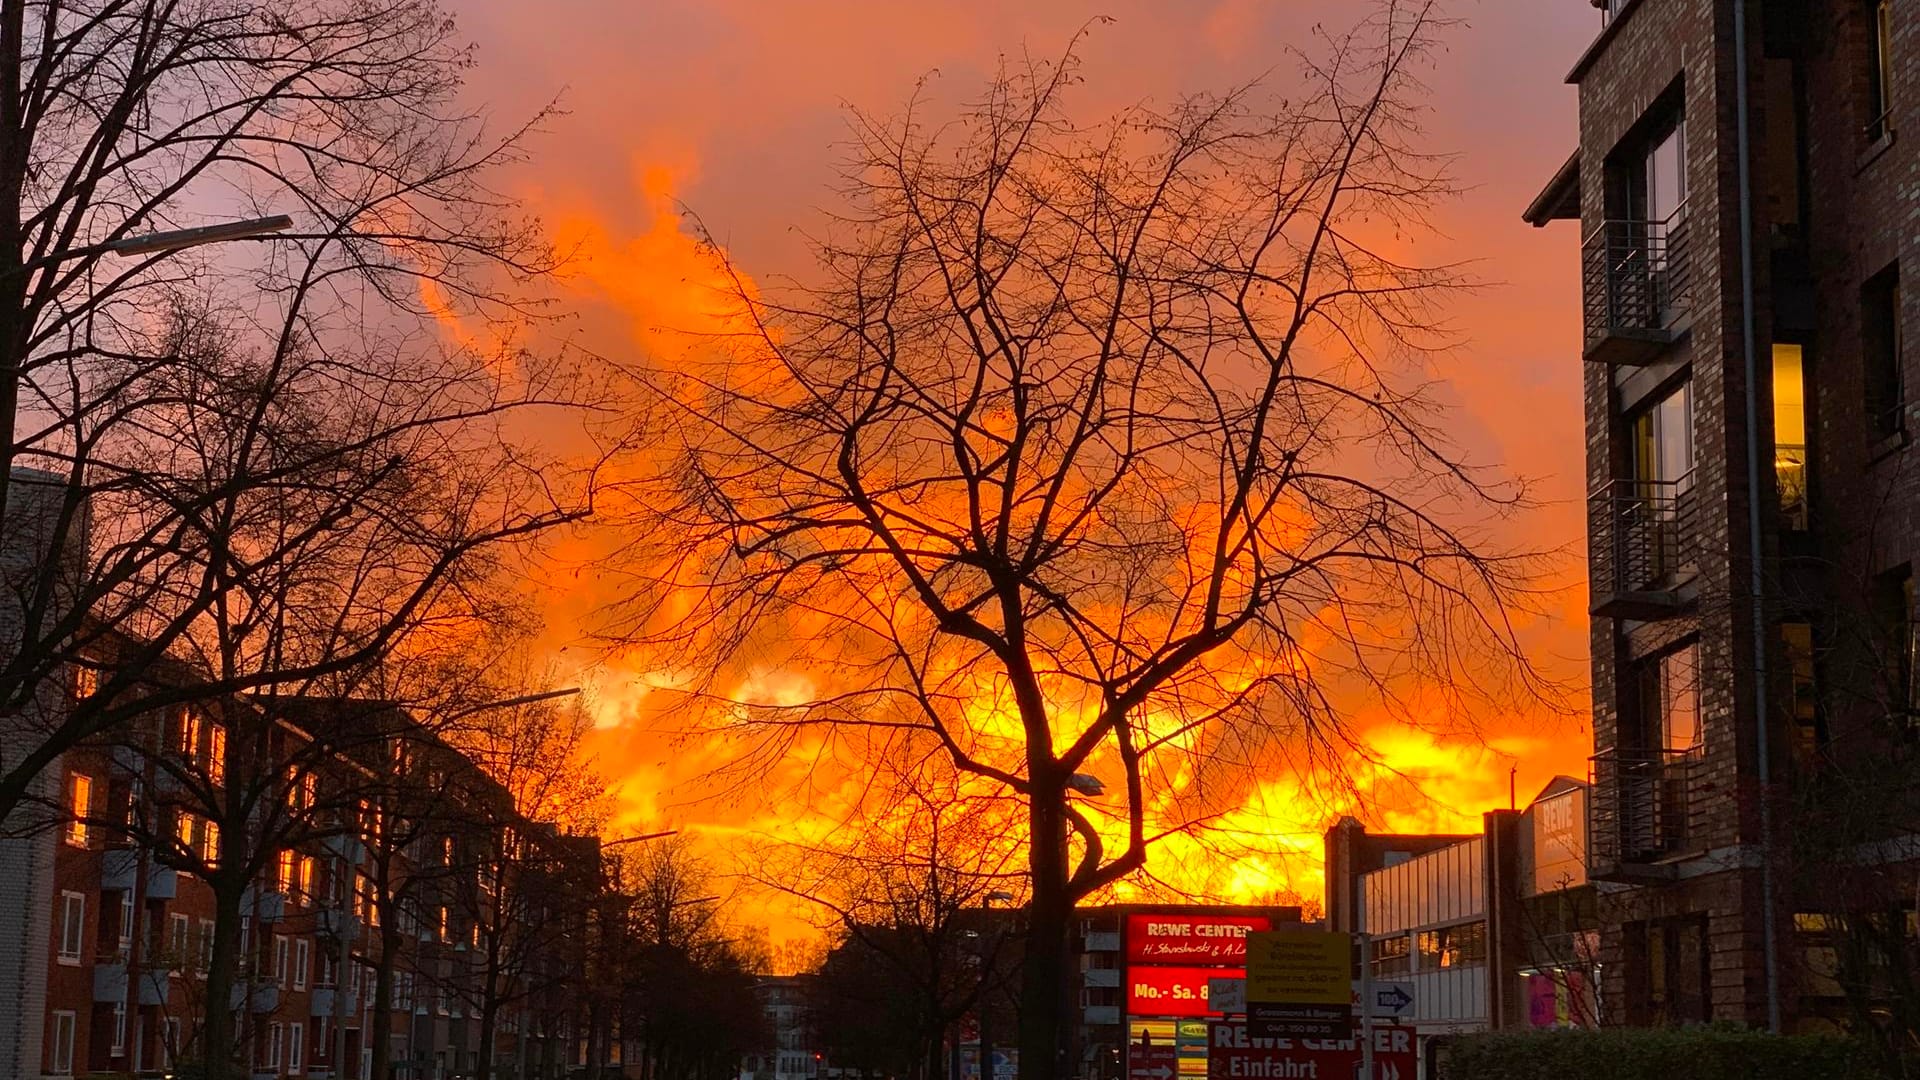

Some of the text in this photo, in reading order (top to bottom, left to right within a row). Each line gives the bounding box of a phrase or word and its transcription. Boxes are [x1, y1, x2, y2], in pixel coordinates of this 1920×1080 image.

[1543, 796, 1573, 834] REWE
[1147, 923, 1191, 936] REWE
[1172, 984, 1196, 999] Sa.
[1230, 1056, 1318, 1079] Einfahrt
